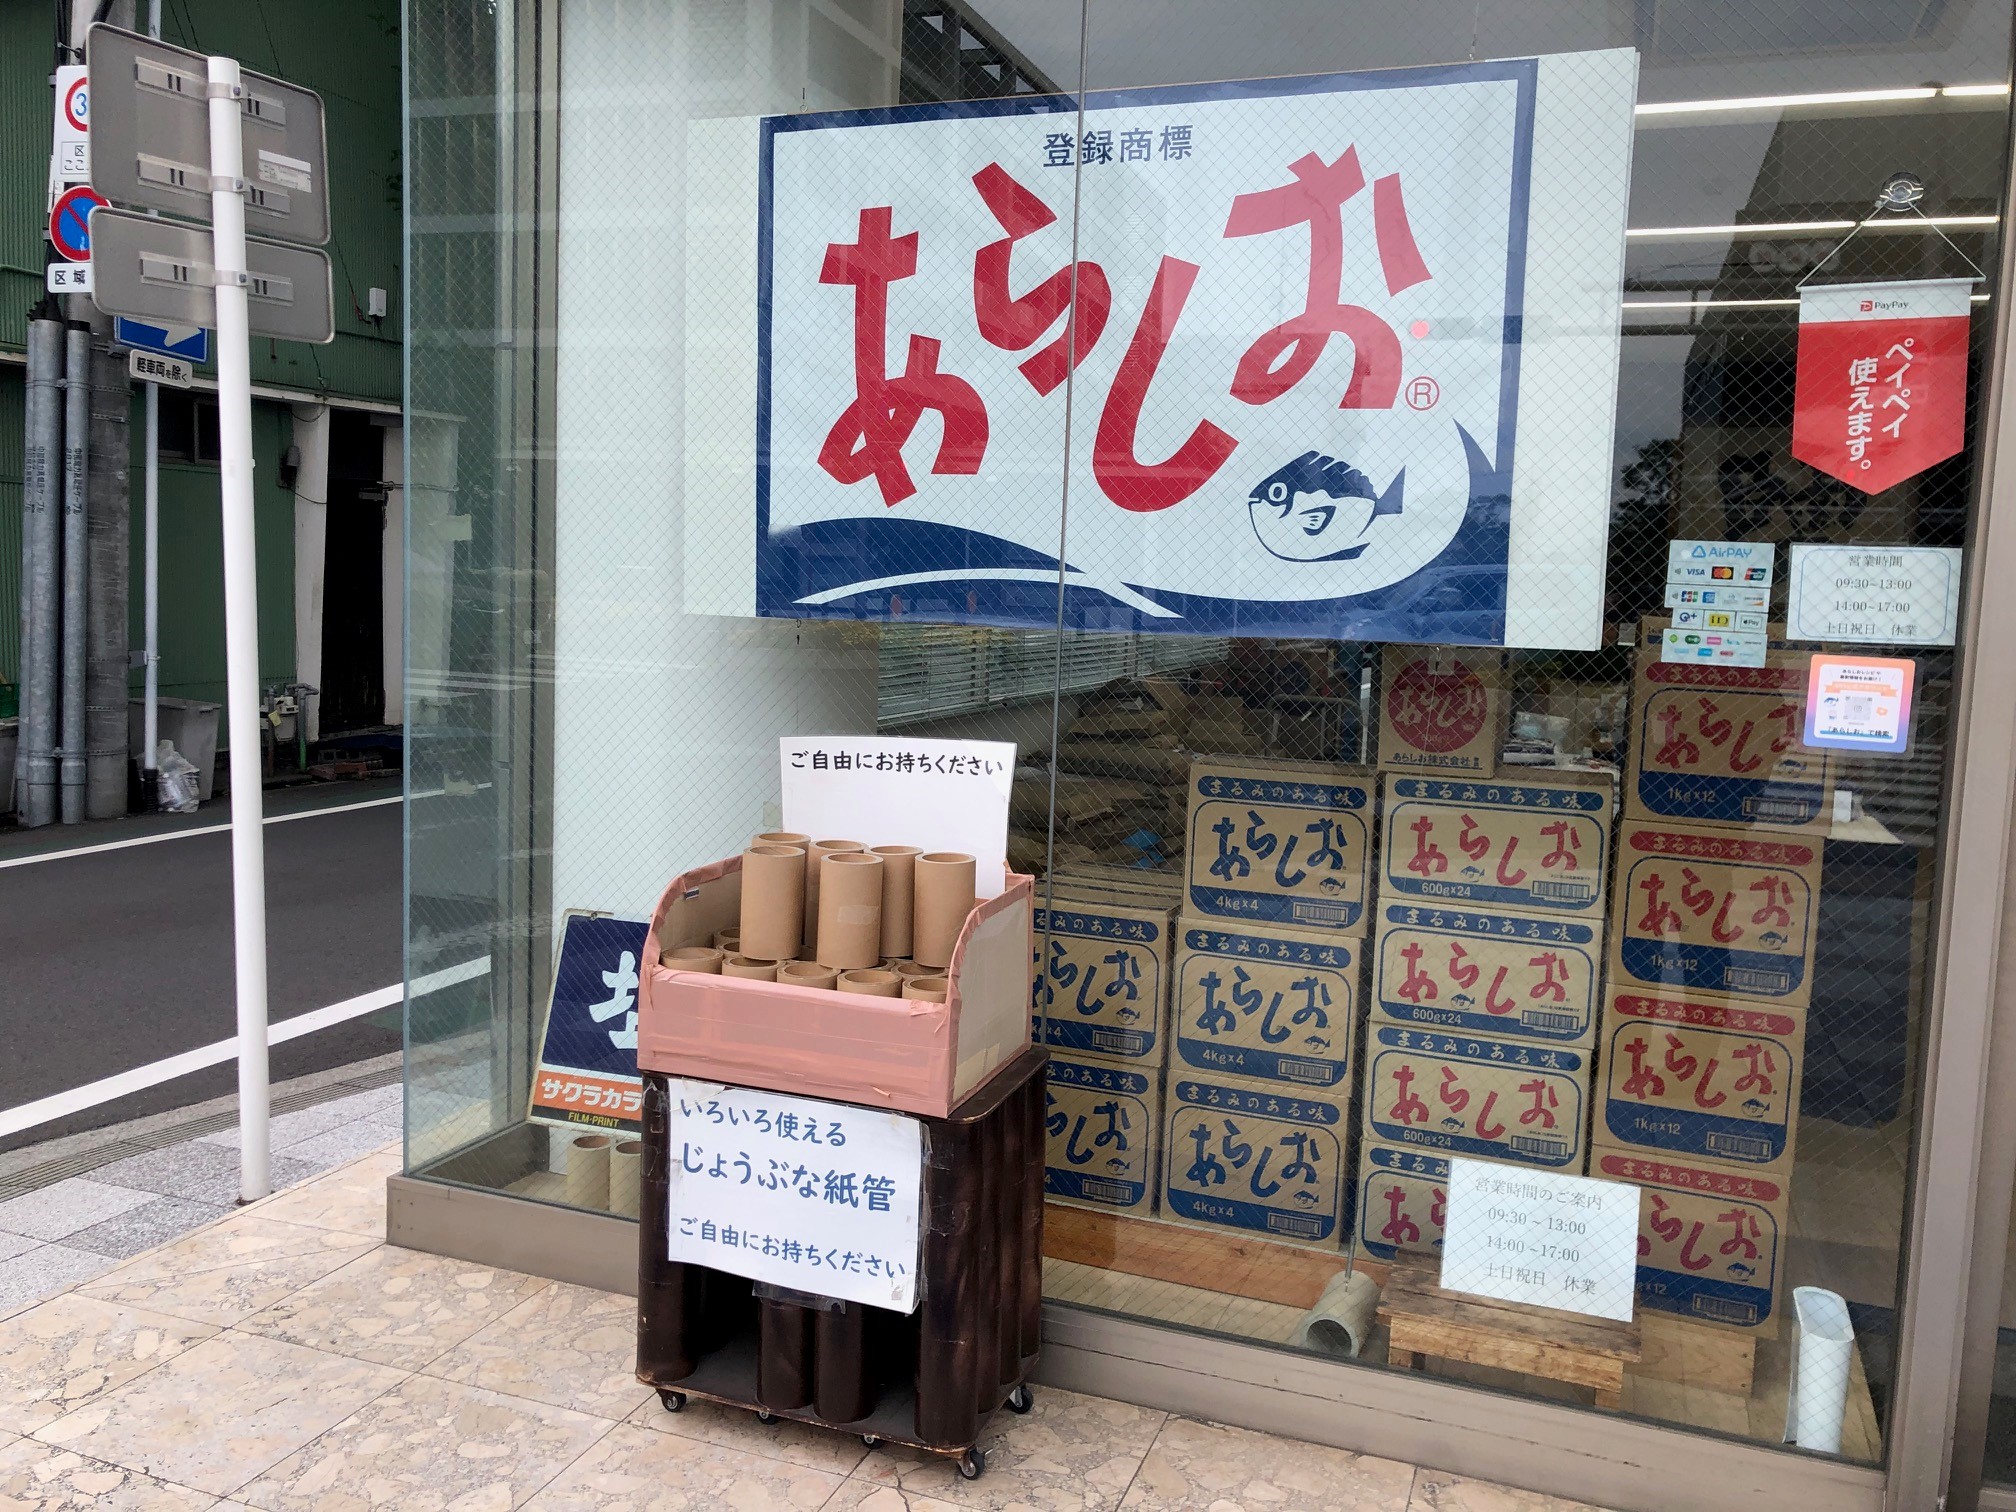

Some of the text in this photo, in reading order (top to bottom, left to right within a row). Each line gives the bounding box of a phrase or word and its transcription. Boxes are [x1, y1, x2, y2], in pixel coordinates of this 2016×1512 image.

[1043, 124, 1194, 168] 登録商標
[1874, 301, 1909, 310] PayPay
[818, 142, 1433, 513] あらしお
[136, 356, 187, 382] 軽車両を除く
[1881, 337, 1914, 438] ペイペイ
[1845, 357, 1880, 471] 使えます。
[1708, 546, 1753, 558] AirPAY
[1849, 554, 1903, 568] 営業時間
[1686, 568, 1706, 576] VISA
[1826, 621, 1918, 636] 土日祝日 休業
[791, 749, 1003, 776] ご自由にお持ちください
[1210, 779, 1354, 808] まるみのある味
[1415, 782, 1582, 810] まるみのある味
[1209, 810, 1348, 888] あらしお
[1408, 813, 1582, 886] あらしお
[1653, 835, 1791, 863] まるみのある味
[1638, 867, 1794, 943] あらしお
[1406, 908, 1572, 942] まるみのある味
[1196, 932, 1339, 965] まるみのある味
[1397, 941, 1570, 1015] あらしお
[1196, 965, 1332, 1044] あらしお
[1636, 1000, 1774, 1031] まるみのある味
[1397, 1030, 1561, 1069] まるみのある味
[1622, 1031, 1778, 1109] あらしお
[1186, 1085, 1327, 1122] まるみのある味
[1389, 1064, 1559, 1140] あらしお
[680, 1098, 846, 1147] いろいろ使える
[682, 1142, 896, 1212] じょうぶな紙管
[1186, 1118, 1321, 1198] あらしお
[1474, 1176, 1603, 1211] 営業時間のご案内
[1622, 1160, 1757, 1197] まるみのある味
[679, 1216, 906, 1279] ご自由にお持ちください
[1637, 1194, 1762, 1271] らしお
[1483, 1262, 1598, 1296] 土日祝日 休業
